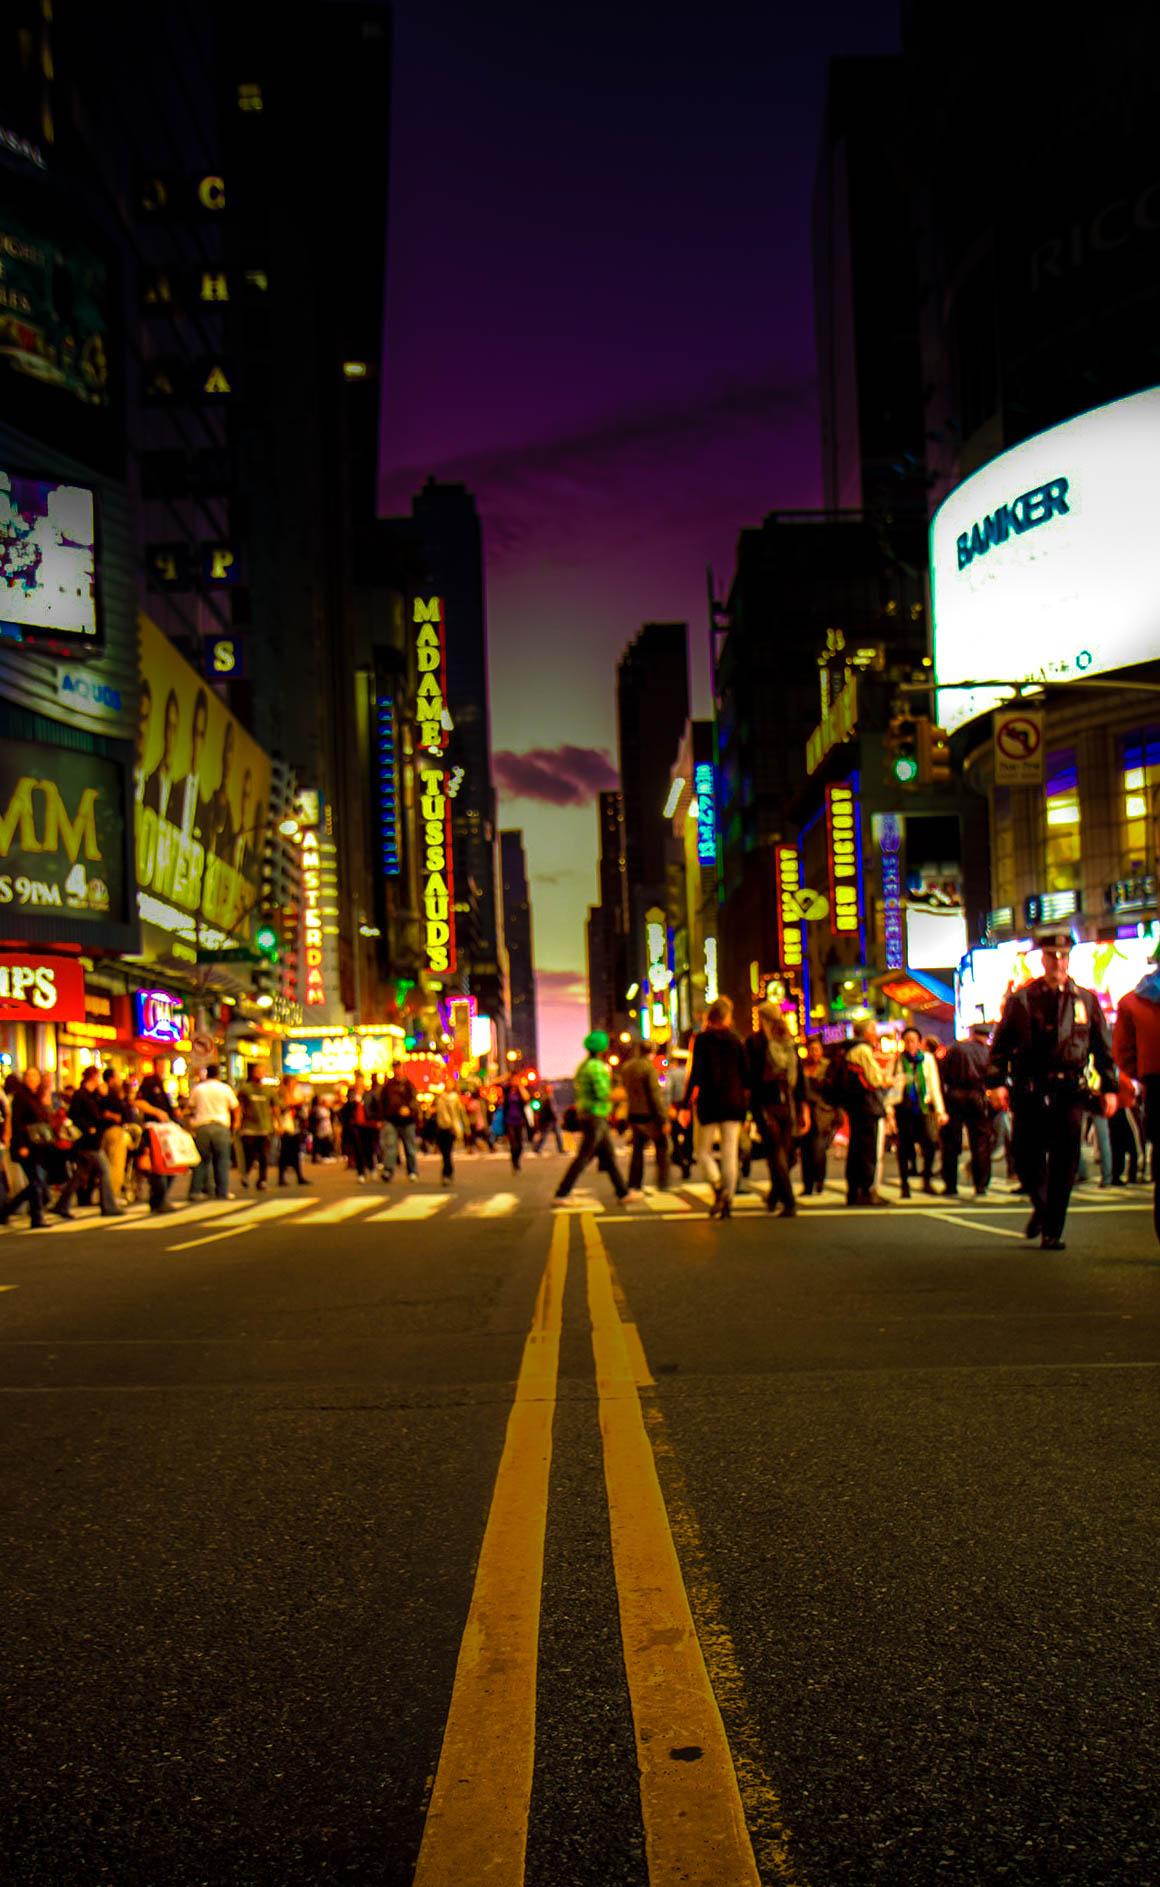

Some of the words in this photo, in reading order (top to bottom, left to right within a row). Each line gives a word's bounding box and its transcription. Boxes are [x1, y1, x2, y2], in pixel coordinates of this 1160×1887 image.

[957, 477, 1069, 571] BANKER
[414, 596, 442, 746] MADAME
[301, 830, 326, 1005] AMSTERDAM
[422, 769, 452, 972] TUSSAUDS
